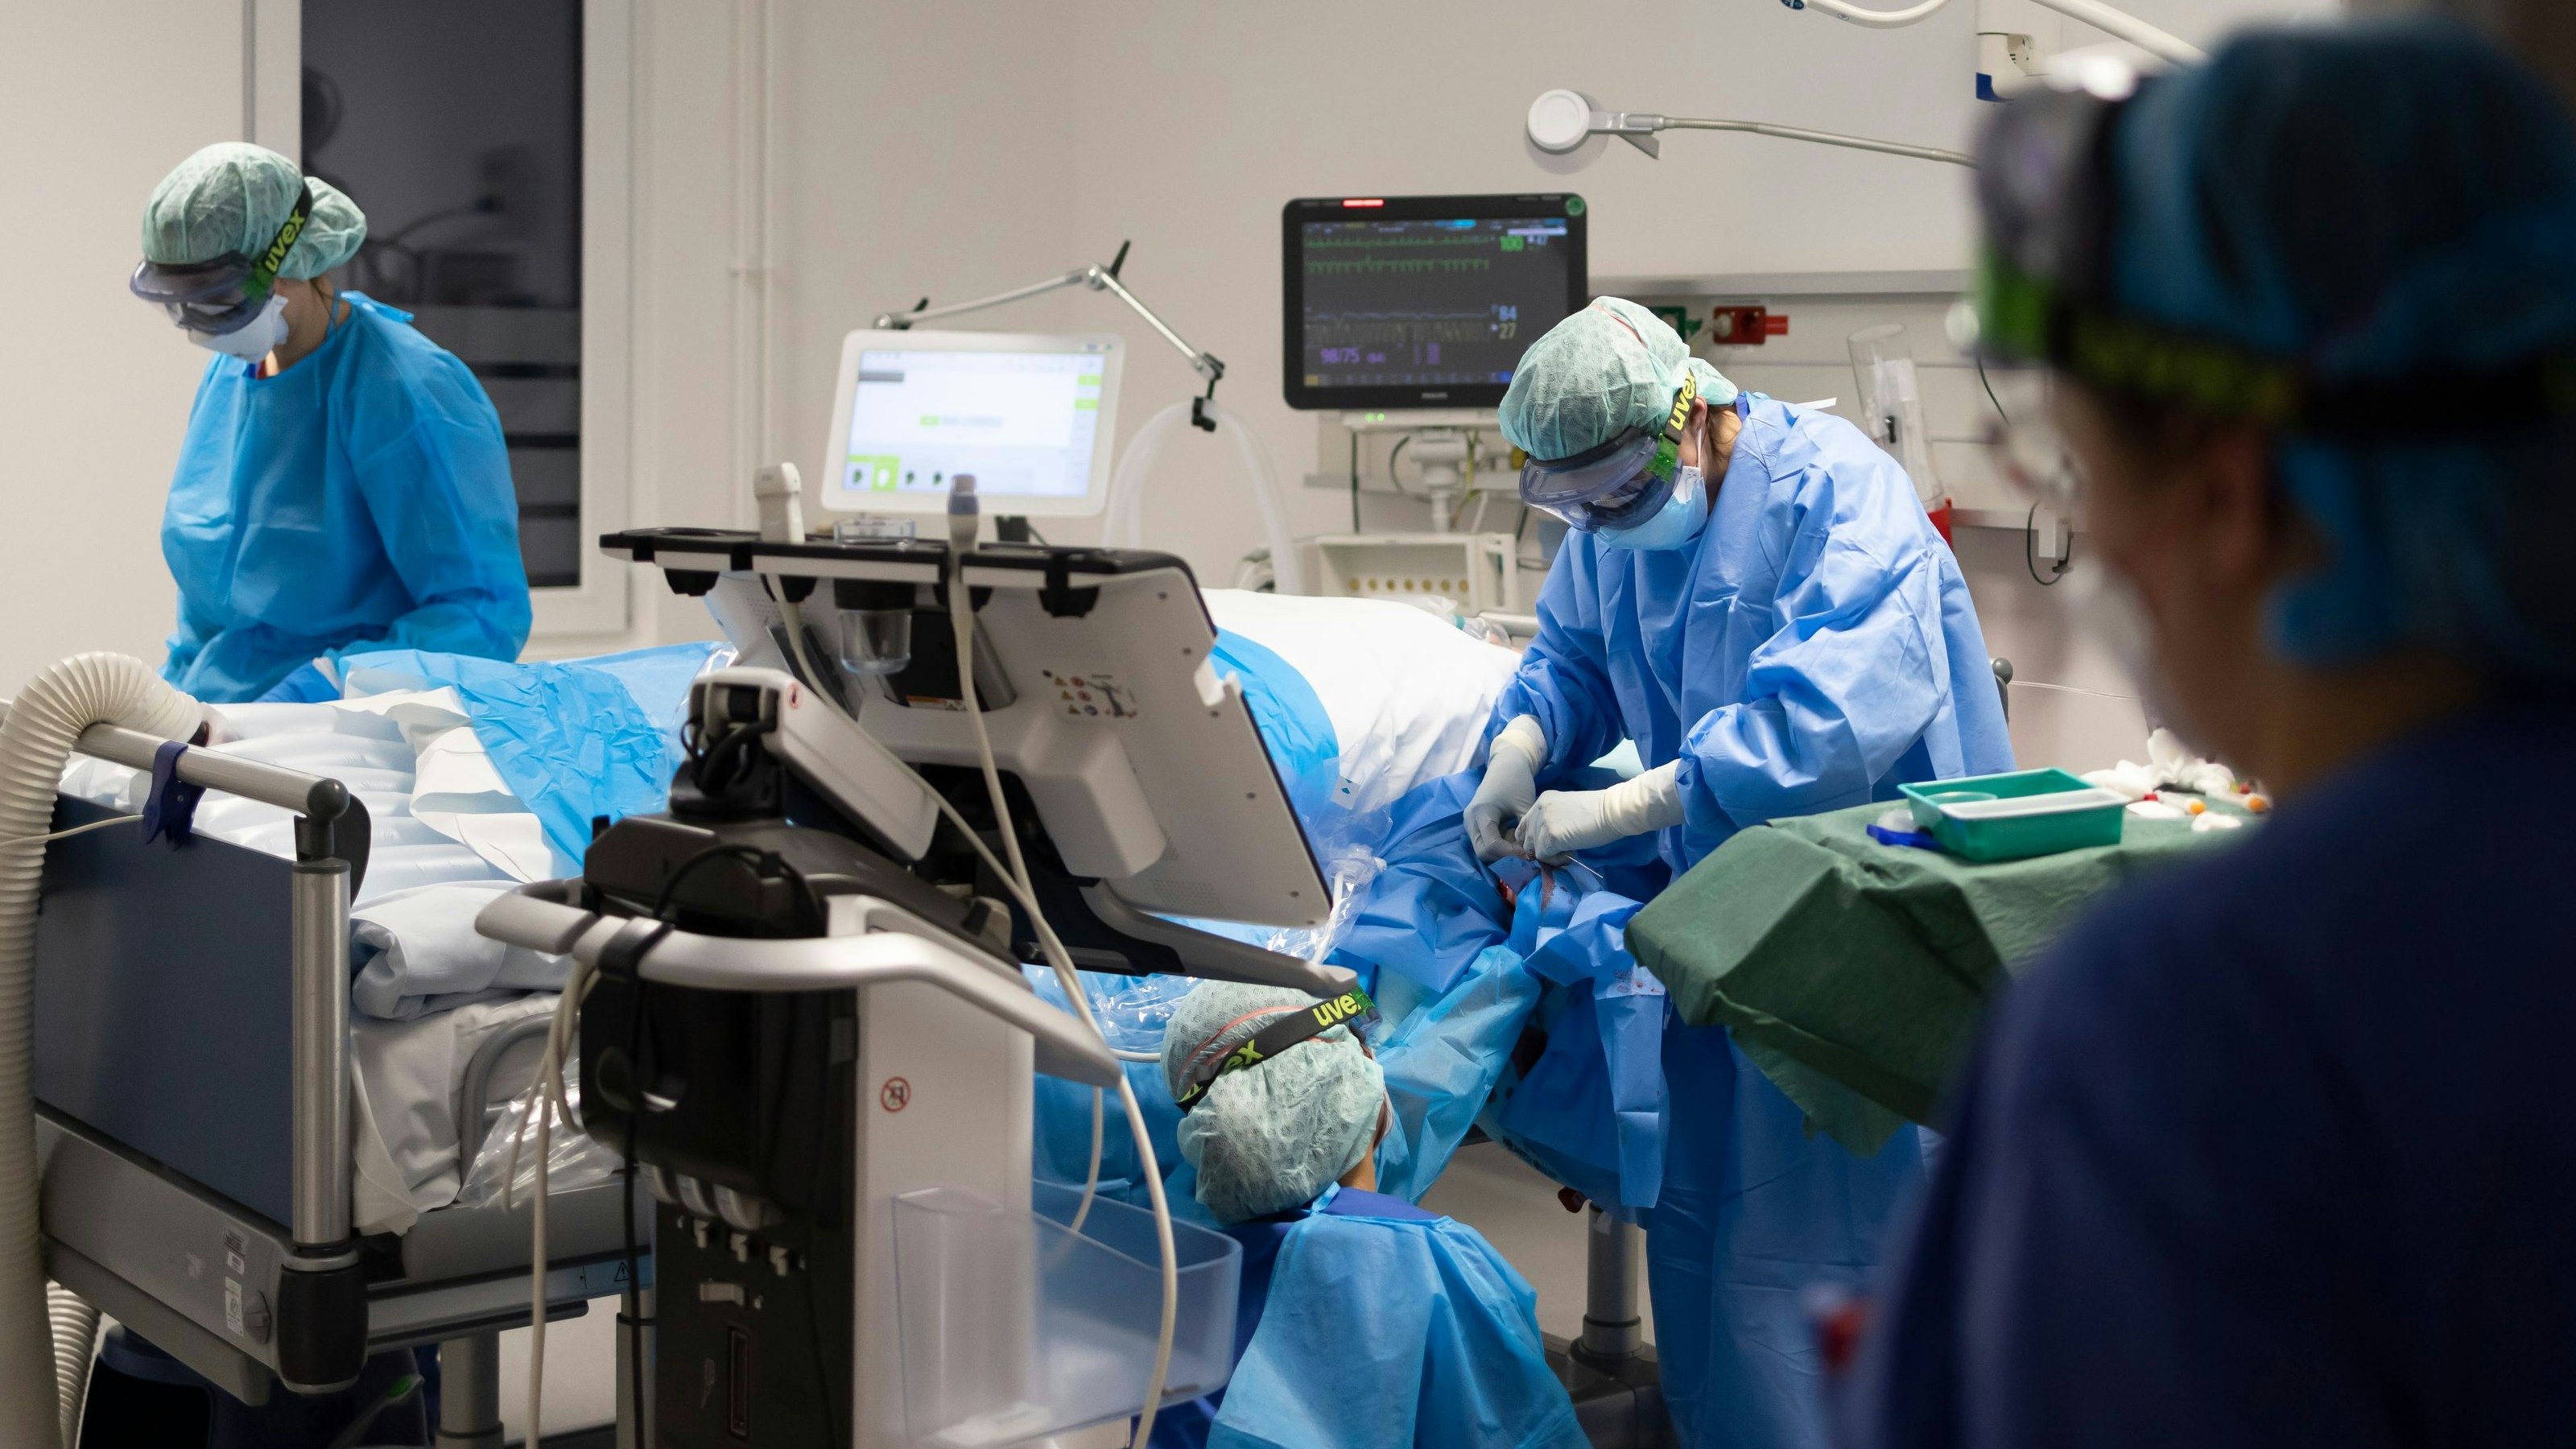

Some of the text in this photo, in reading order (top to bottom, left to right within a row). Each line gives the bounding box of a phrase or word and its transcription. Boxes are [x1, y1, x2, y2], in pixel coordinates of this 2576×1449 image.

[265, 208, 305, 273] uvex
[1498, 322, 1517, 340] 27
[1312, 993, 1361, 1026] uve
